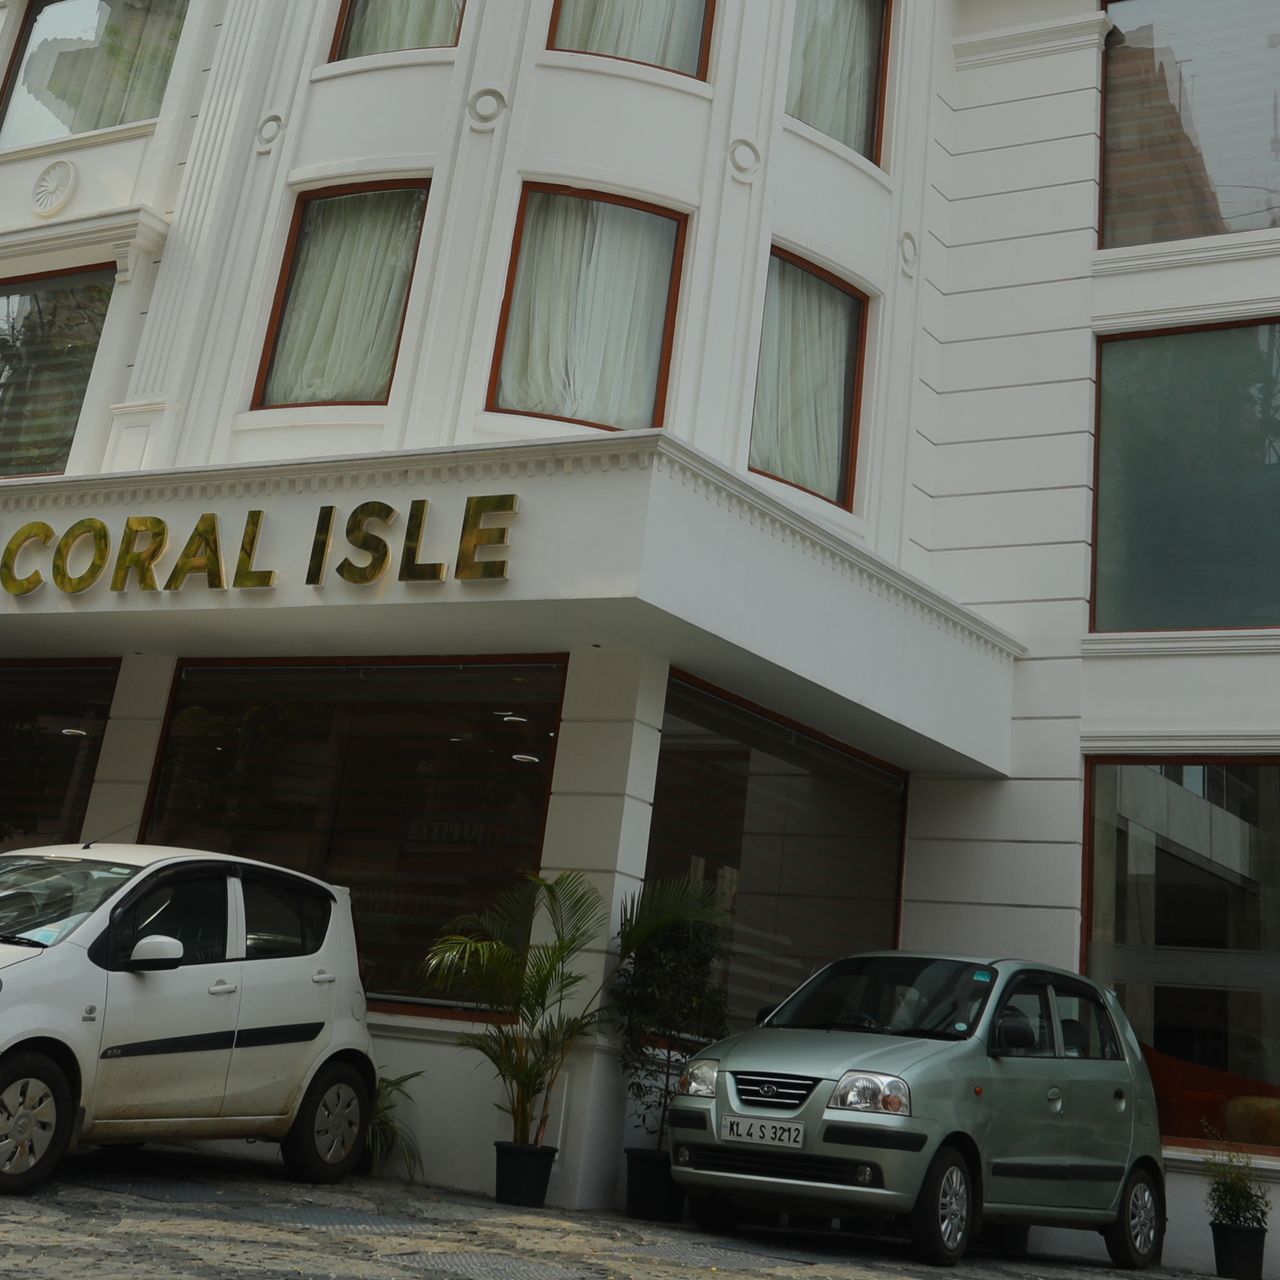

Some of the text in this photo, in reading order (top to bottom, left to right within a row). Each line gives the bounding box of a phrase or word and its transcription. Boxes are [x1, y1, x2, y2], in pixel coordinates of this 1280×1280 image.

[0, 494, 519, 597] CORAL ISLE
[728, 1120, 801, 1144] KL 4 S 3212
